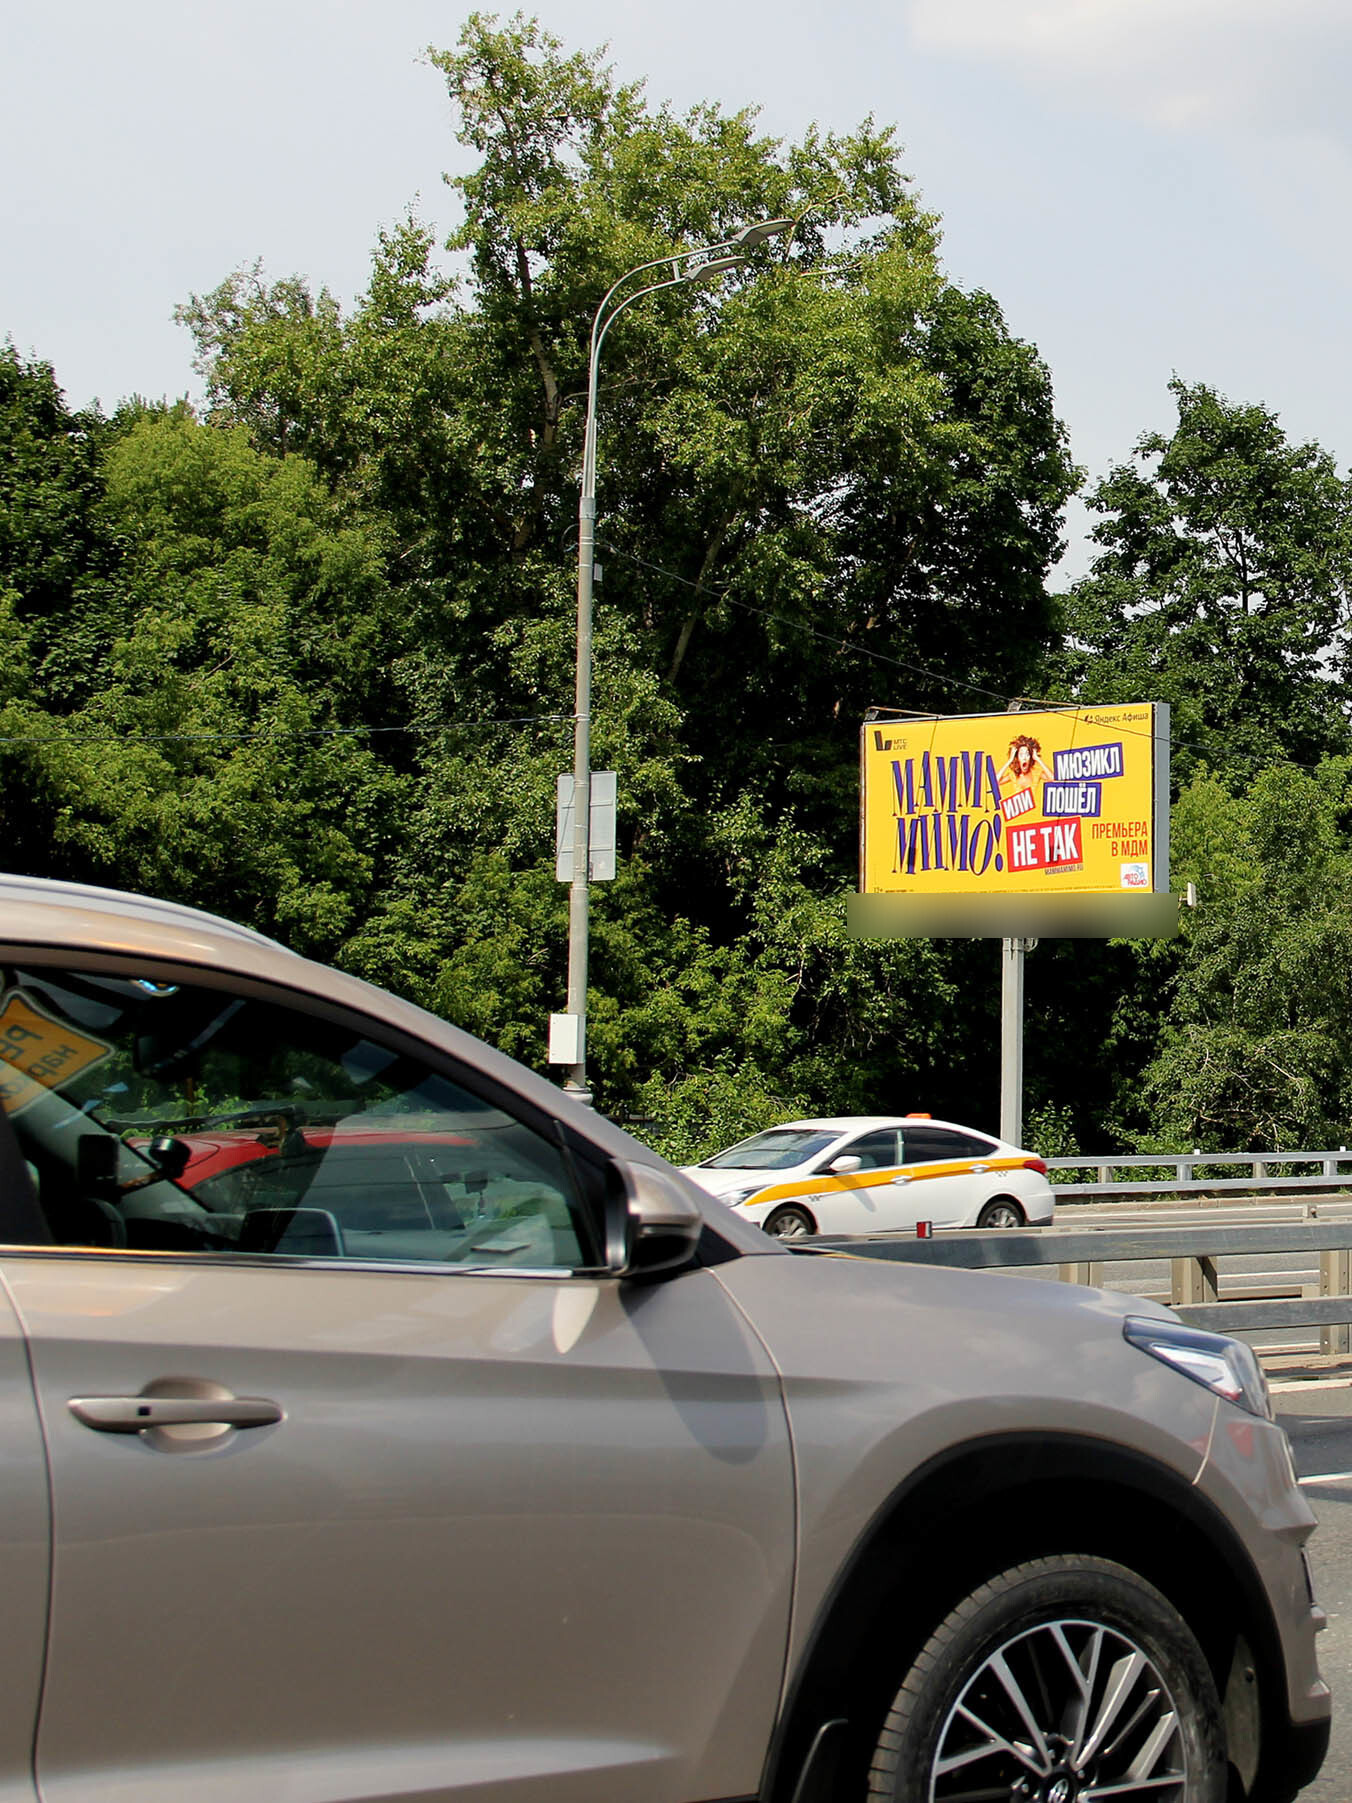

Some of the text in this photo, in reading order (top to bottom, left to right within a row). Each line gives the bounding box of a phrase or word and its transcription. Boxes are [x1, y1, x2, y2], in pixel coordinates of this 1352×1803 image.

[1122, 712, 1149, 722] Афиша
[1056, 746, 1121, 781] МЮЗИКЛ
[890, 751, 1002, 816] МАММА
[1046, 783, 1097, 814] ПОШЁЛ
[1003, 789, 1034, 820] ИЛИ
[891, 813, 1004, 876] МИМО!
[1012, 823, 1079, 868] НЕ ТАК
[1091, 821, 1148, 840] ПРЕМЬЕРА
[1111, 839, 1148, 858] В МДМ
